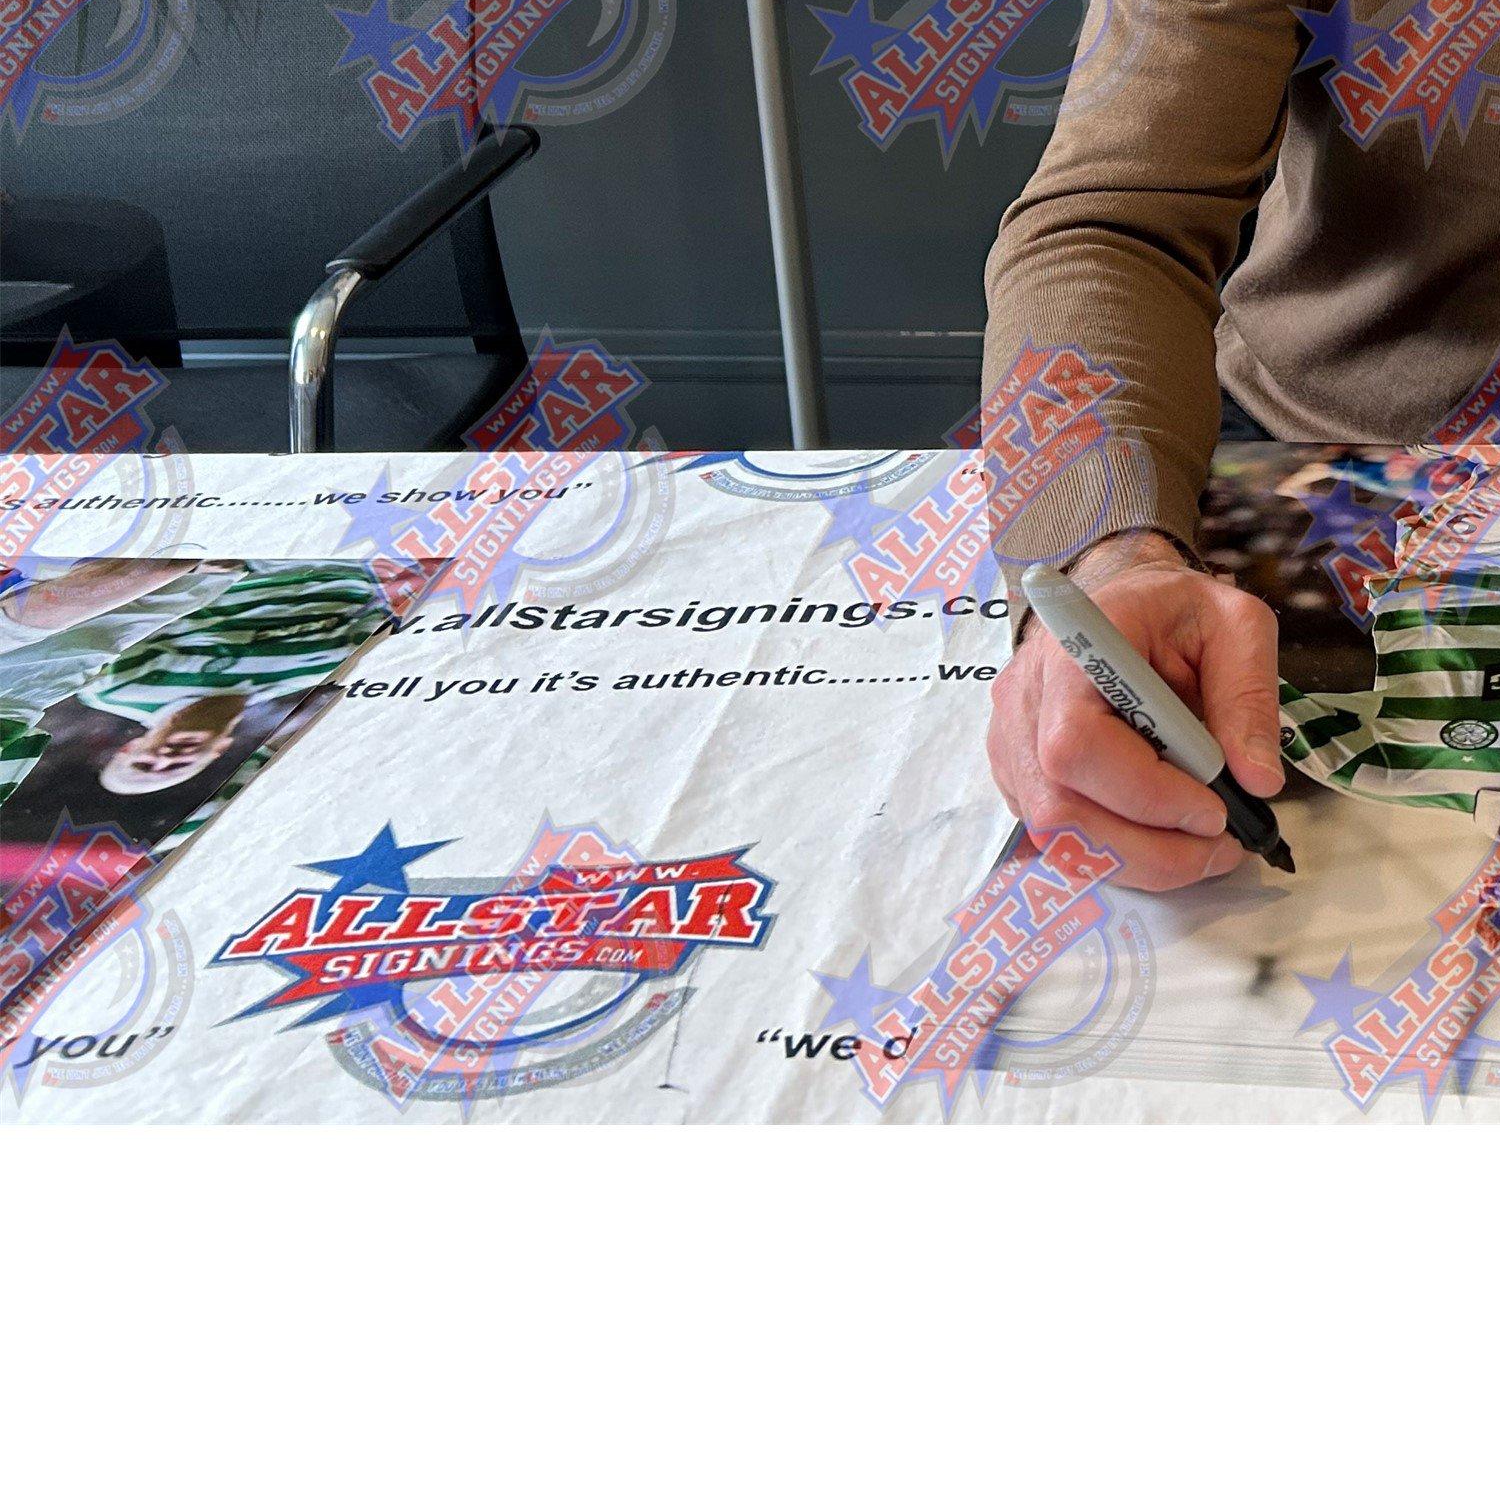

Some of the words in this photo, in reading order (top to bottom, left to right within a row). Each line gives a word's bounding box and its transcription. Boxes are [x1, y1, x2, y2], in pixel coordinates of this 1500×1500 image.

[377, 488, 492, 504] show
[488, 482, 593, 505] you”
[345, 676, 424, 699] tell
[423, 677, 520, 703] you
[530, 670, 600, 693] it’s
[220, 877, 766, 960] ALLSTAR
[13, 1025, 175, 1070] you”
